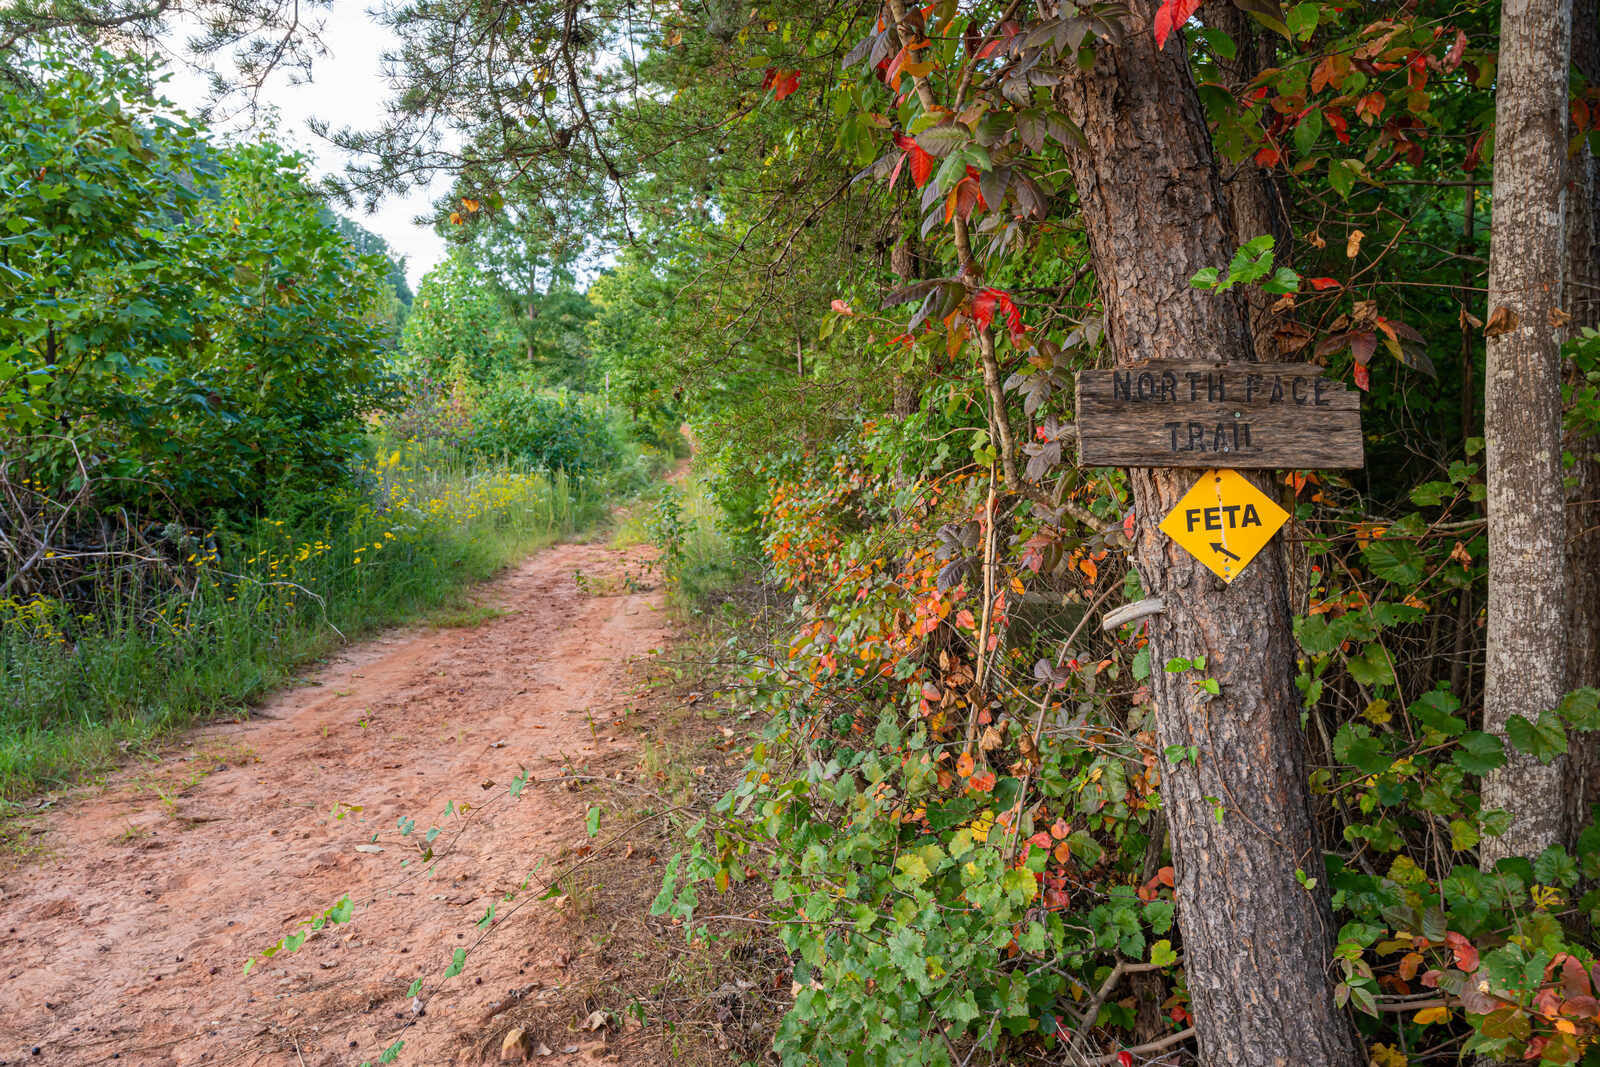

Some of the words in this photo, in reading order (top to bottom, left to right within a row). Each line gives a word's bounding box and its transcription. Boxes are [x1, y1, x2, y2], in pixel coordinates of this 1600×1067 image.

[1113, 371, 1226, 403] NORTH
[1246, 374, 1329, 406] FACE
[1164, 422, 1263, 452] TRAIL
[1186, 504, 1262, 532] FETA
